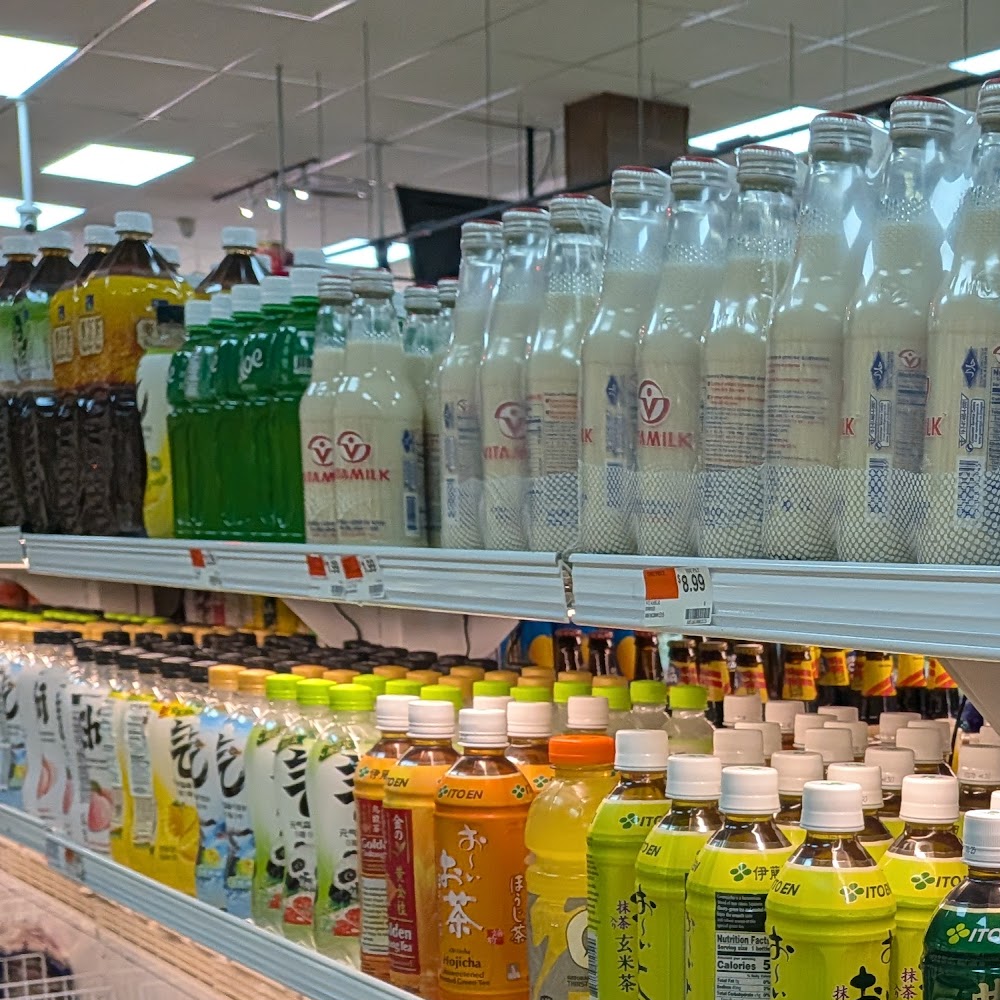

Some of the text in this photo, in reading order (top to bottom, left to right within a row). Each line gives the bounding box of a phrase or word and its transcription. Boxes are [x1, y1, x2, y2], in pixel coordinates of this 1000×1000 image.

[780, 881, 800, 897] EN
[717, 934, 748, 945] Nutrition
[615, 934, 637, 993] 玄米茶
[717, 959, 771, 971] Calories 5
